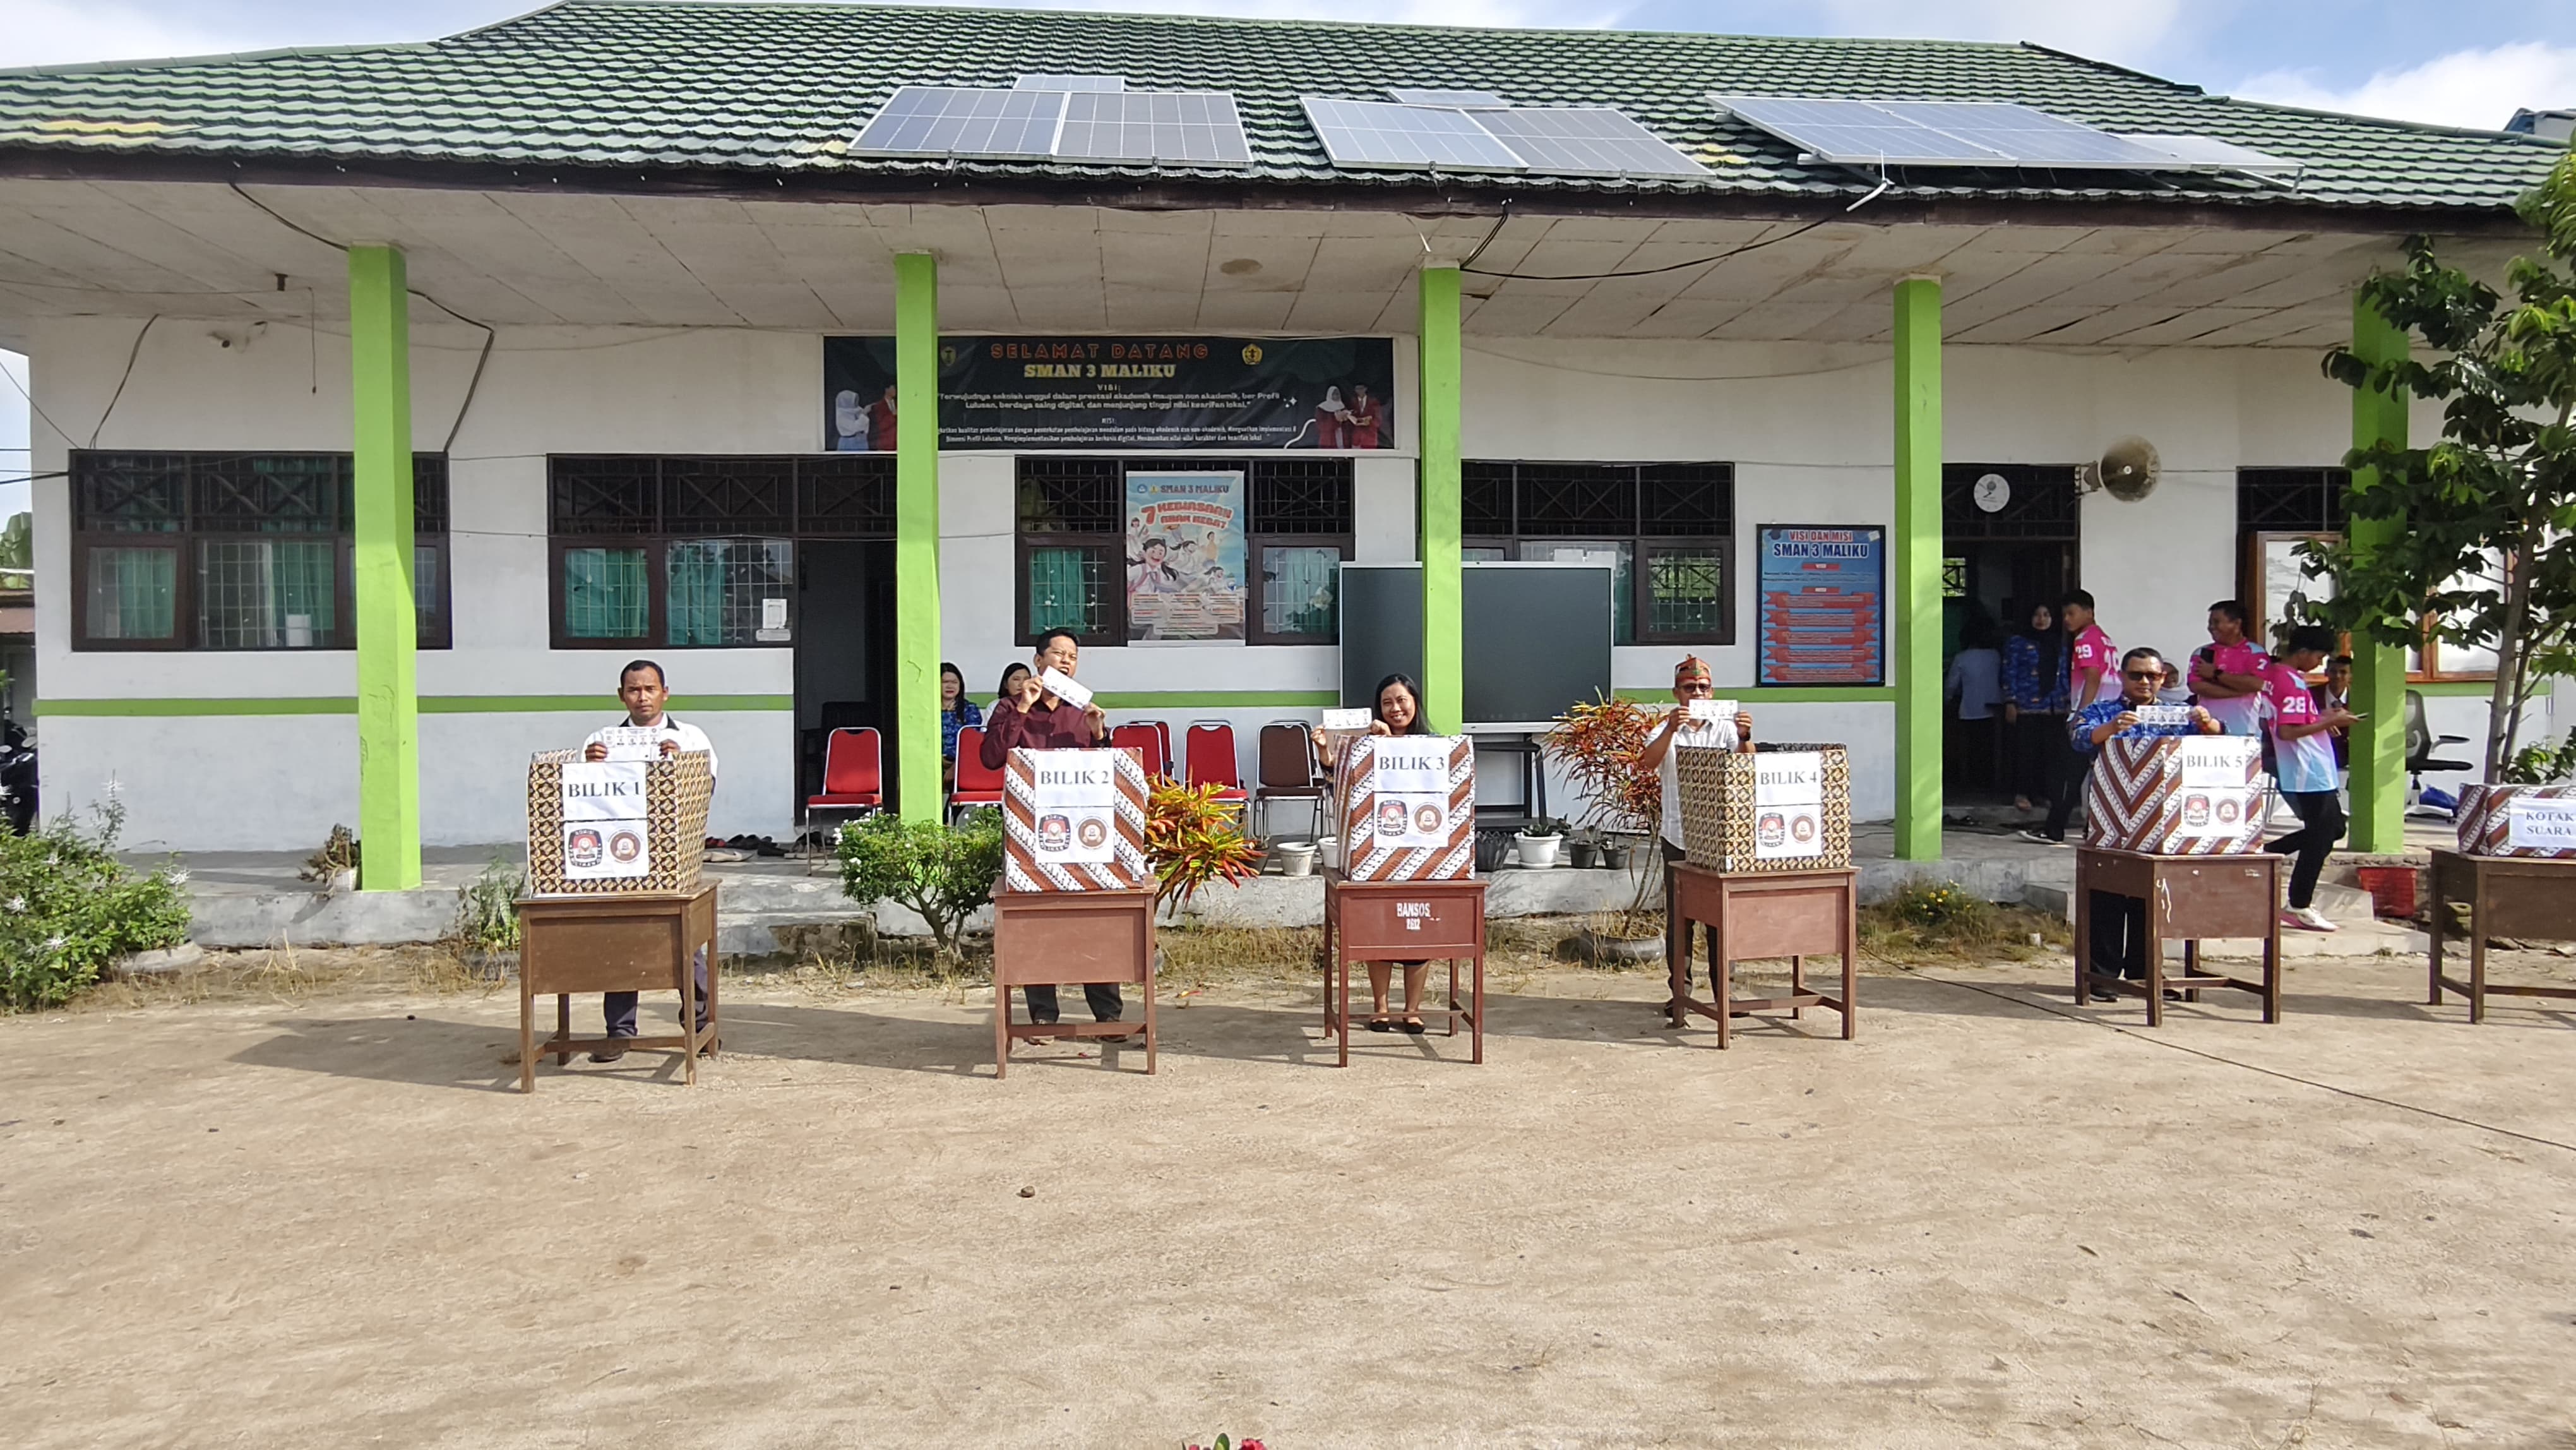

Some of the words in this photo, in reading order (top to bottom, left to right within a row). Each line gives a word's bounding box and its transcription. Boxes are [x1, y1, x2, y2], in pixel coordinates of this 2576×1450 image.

[991, 344, 1099, 359] SELAMAT
[1111, 344, 1208, 359] DATANG
[1023, 364, 1081, 377] SMAN
[1086, 364, 1096, 377] 3
[1101, 364, 1176, 377] MALIKU
[1025, 393, 1051, 401] unggul
[1078, 393, 1112, 401] prestasi
[1160, 485, 1186, 494] SMAN
[1195, 485, 1229, 494] MALIKU
[1142, 506, 1156, 525] 7
[1789, 531, 1808, 541] VISI
[1811, 531, 1830, 541] DAN
[1832, 531, 1853, 541] MISI
[1774, 543, 1808, 556] SMAN
[1812, 544, 1820, 556] 3
[1823, 544, 1868, 557] MALIKU
[2257, 659, 2268, 670] 7
[2282, 696, 2306, 713] 28
[1379, 757, 1433, 770] BILIK
[1436, 757, 1445, 770] 3
[2186, 755, 2231, 768] BILIK
[2235, 755, 2242, 768] 5
[1041, 770, 1095, 785] BILIK
[1101, 770, 1110, 784] 2
[1760, 771, 1806, 785] BILIK
[1809, 772, 1817, 783] 4
[568, 781, 626, 798] BILIK
[633, 781, 640, 796] 1
[2527, 812, 2574, 822] KOTAK
[2527, 825, 2572, 836] SUARA
[1396, 902, 1431, 917] BANSOS
